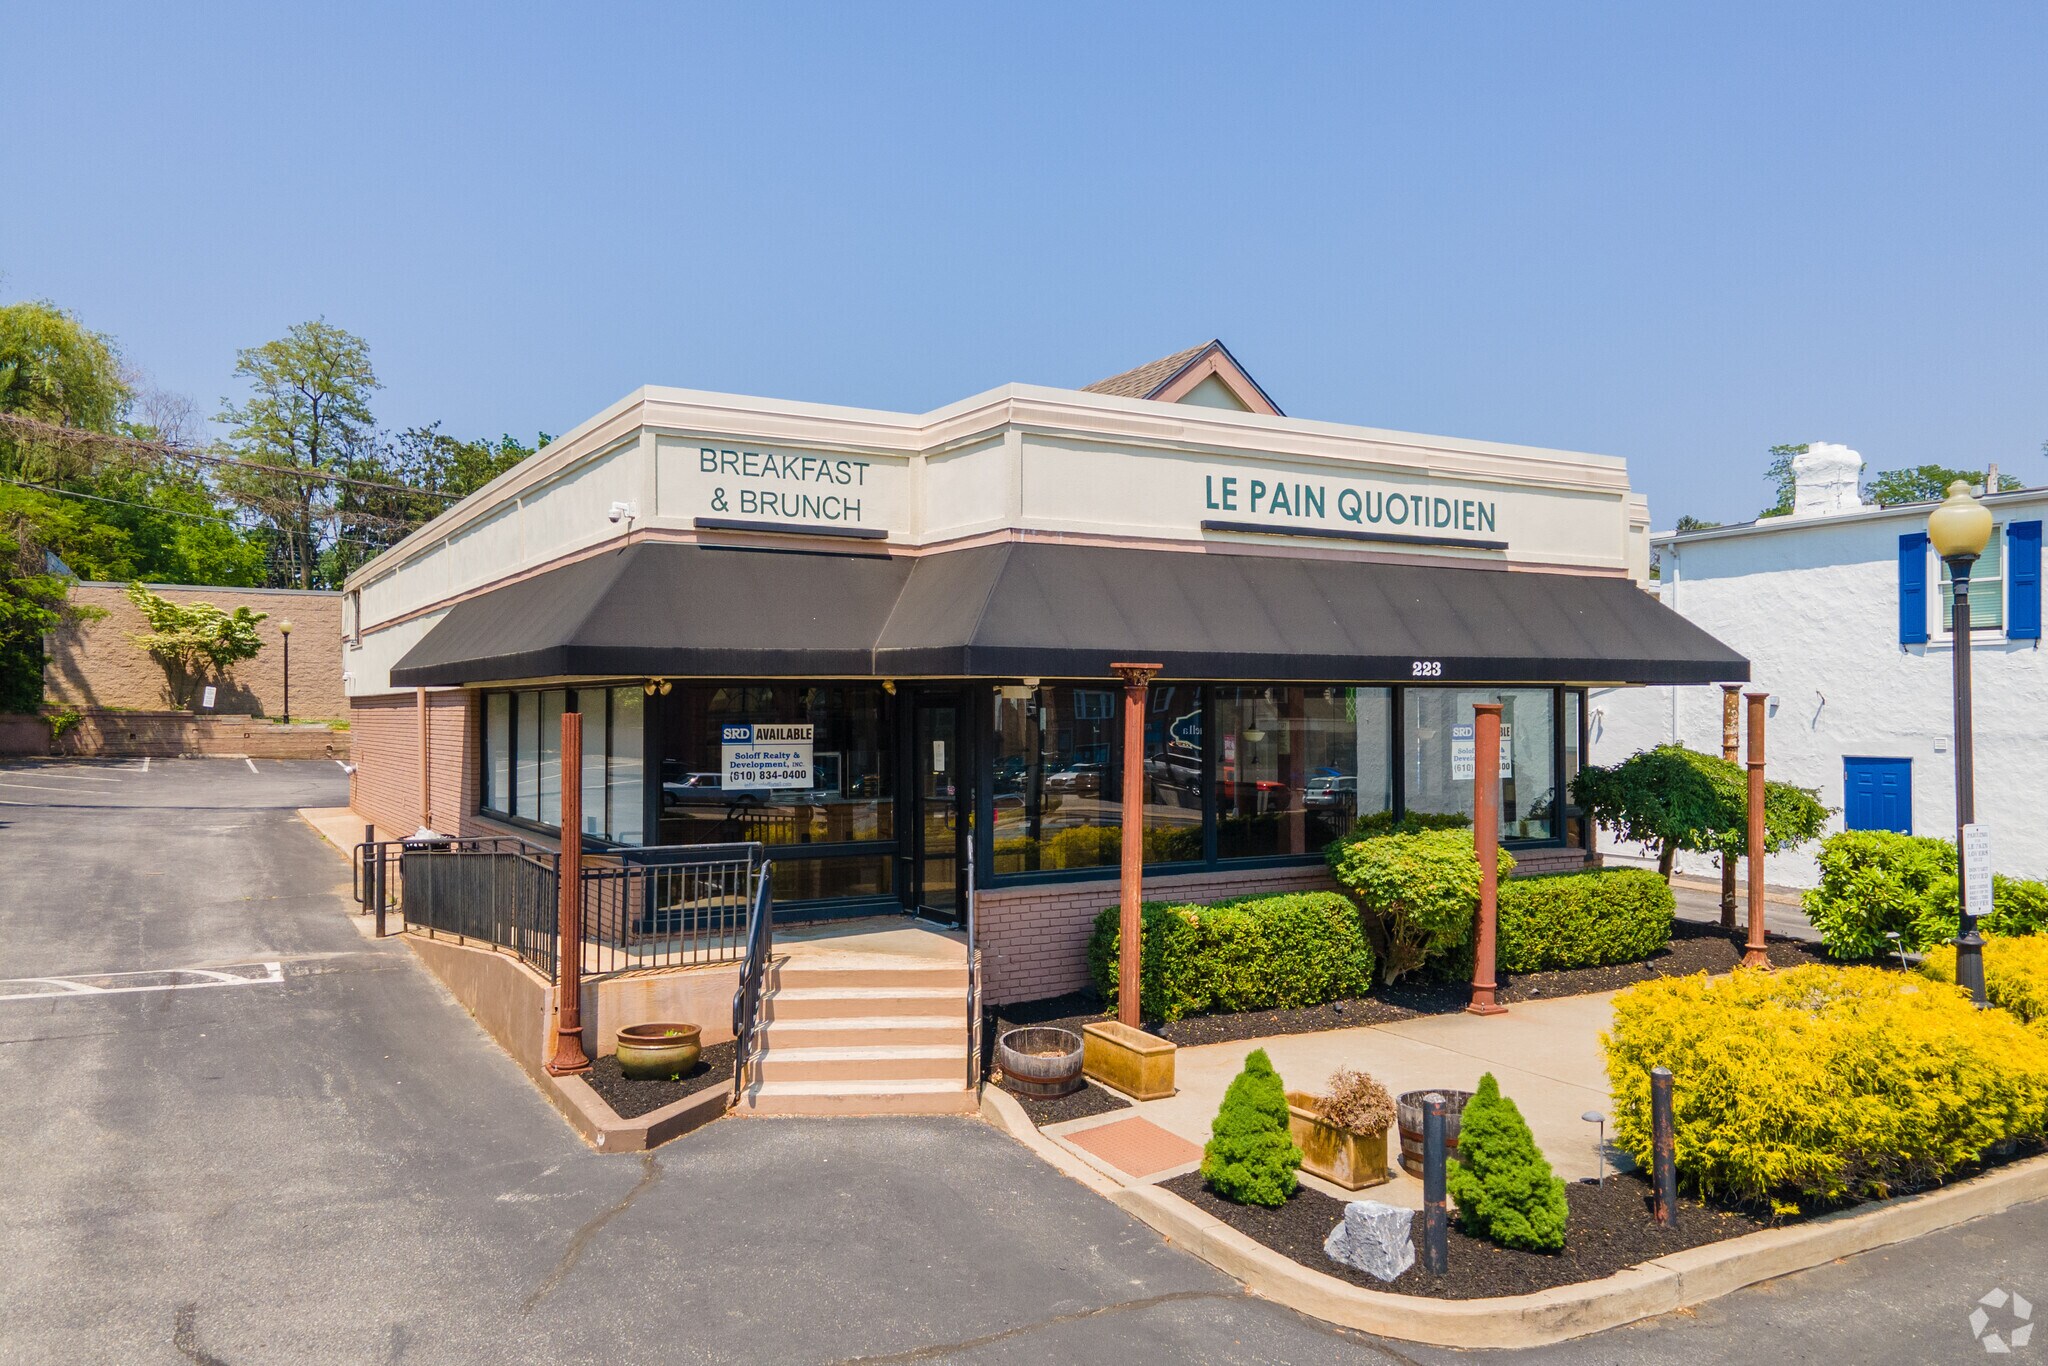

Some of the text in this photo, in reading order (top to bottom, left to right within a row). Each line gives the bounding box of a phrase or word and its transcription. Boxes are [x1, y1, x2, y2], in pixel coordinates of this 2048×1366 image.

[700, 447, 870, 486] BREAKFAST
[711, 487, 861, 522] & BRUNCH
[1206, 475, 1495, 532] LE PAIN QUOTIDIEN
[1412, 661, 1442, 676] 223
[723, 728, 812, 741] SRD AVAILABLE
[1453, 727, 1473, 737] SRD
[735, 752, 761, 760] Soloff
[763, 752, 791, 760] Realty
[730, 761, 790, 769] Development,
[1454, 764, 1473, 773] (610)
[730, 770, 807, 782] (610) 834-0400
